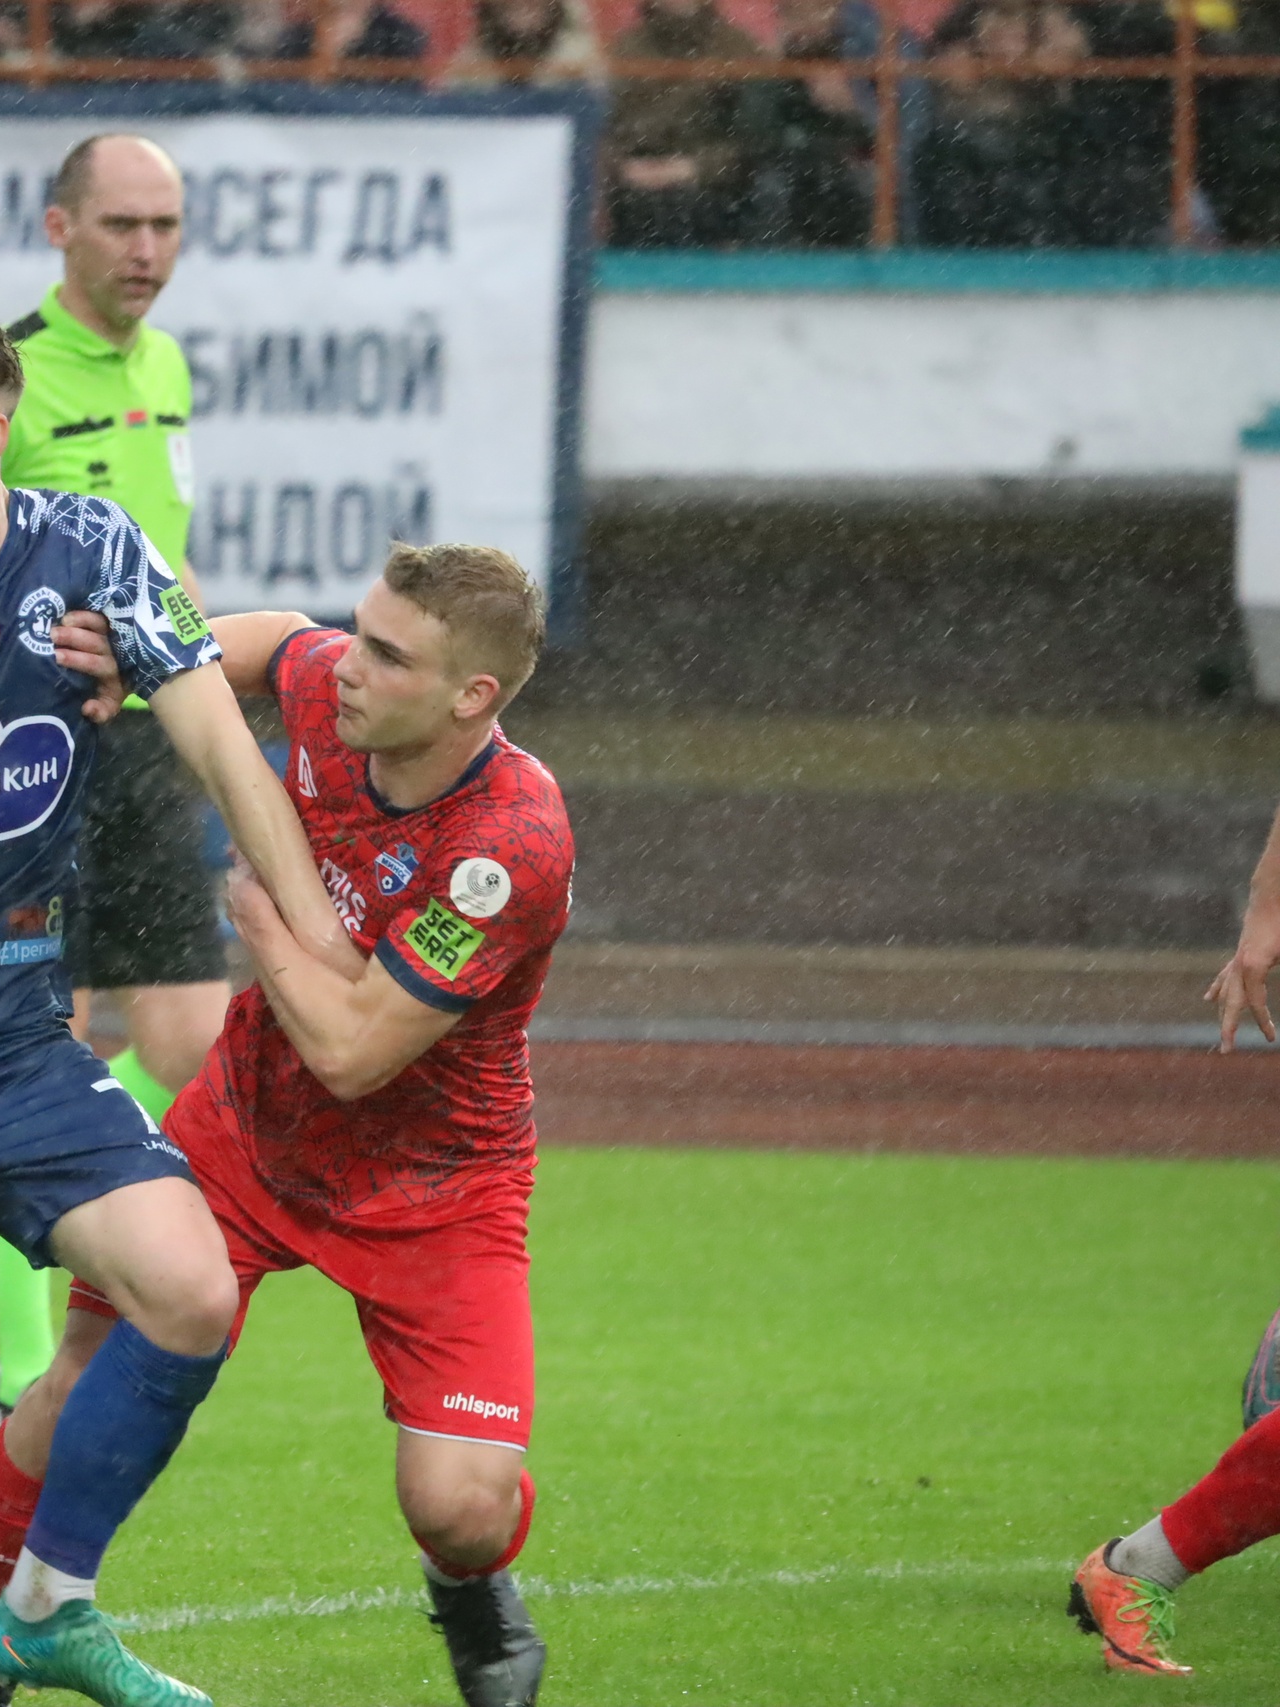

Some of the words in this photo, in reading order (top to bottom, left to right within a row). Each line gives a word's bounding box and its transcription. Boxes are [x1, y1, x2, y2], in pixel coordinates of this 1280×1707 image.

[182, 167, 453, 266] СЕГДА
[187, 314, 446, 421] БИМОЙ
[381, 857, 406, 880] МИНСК
[442, 1392, 519, 1422] uhlsport
